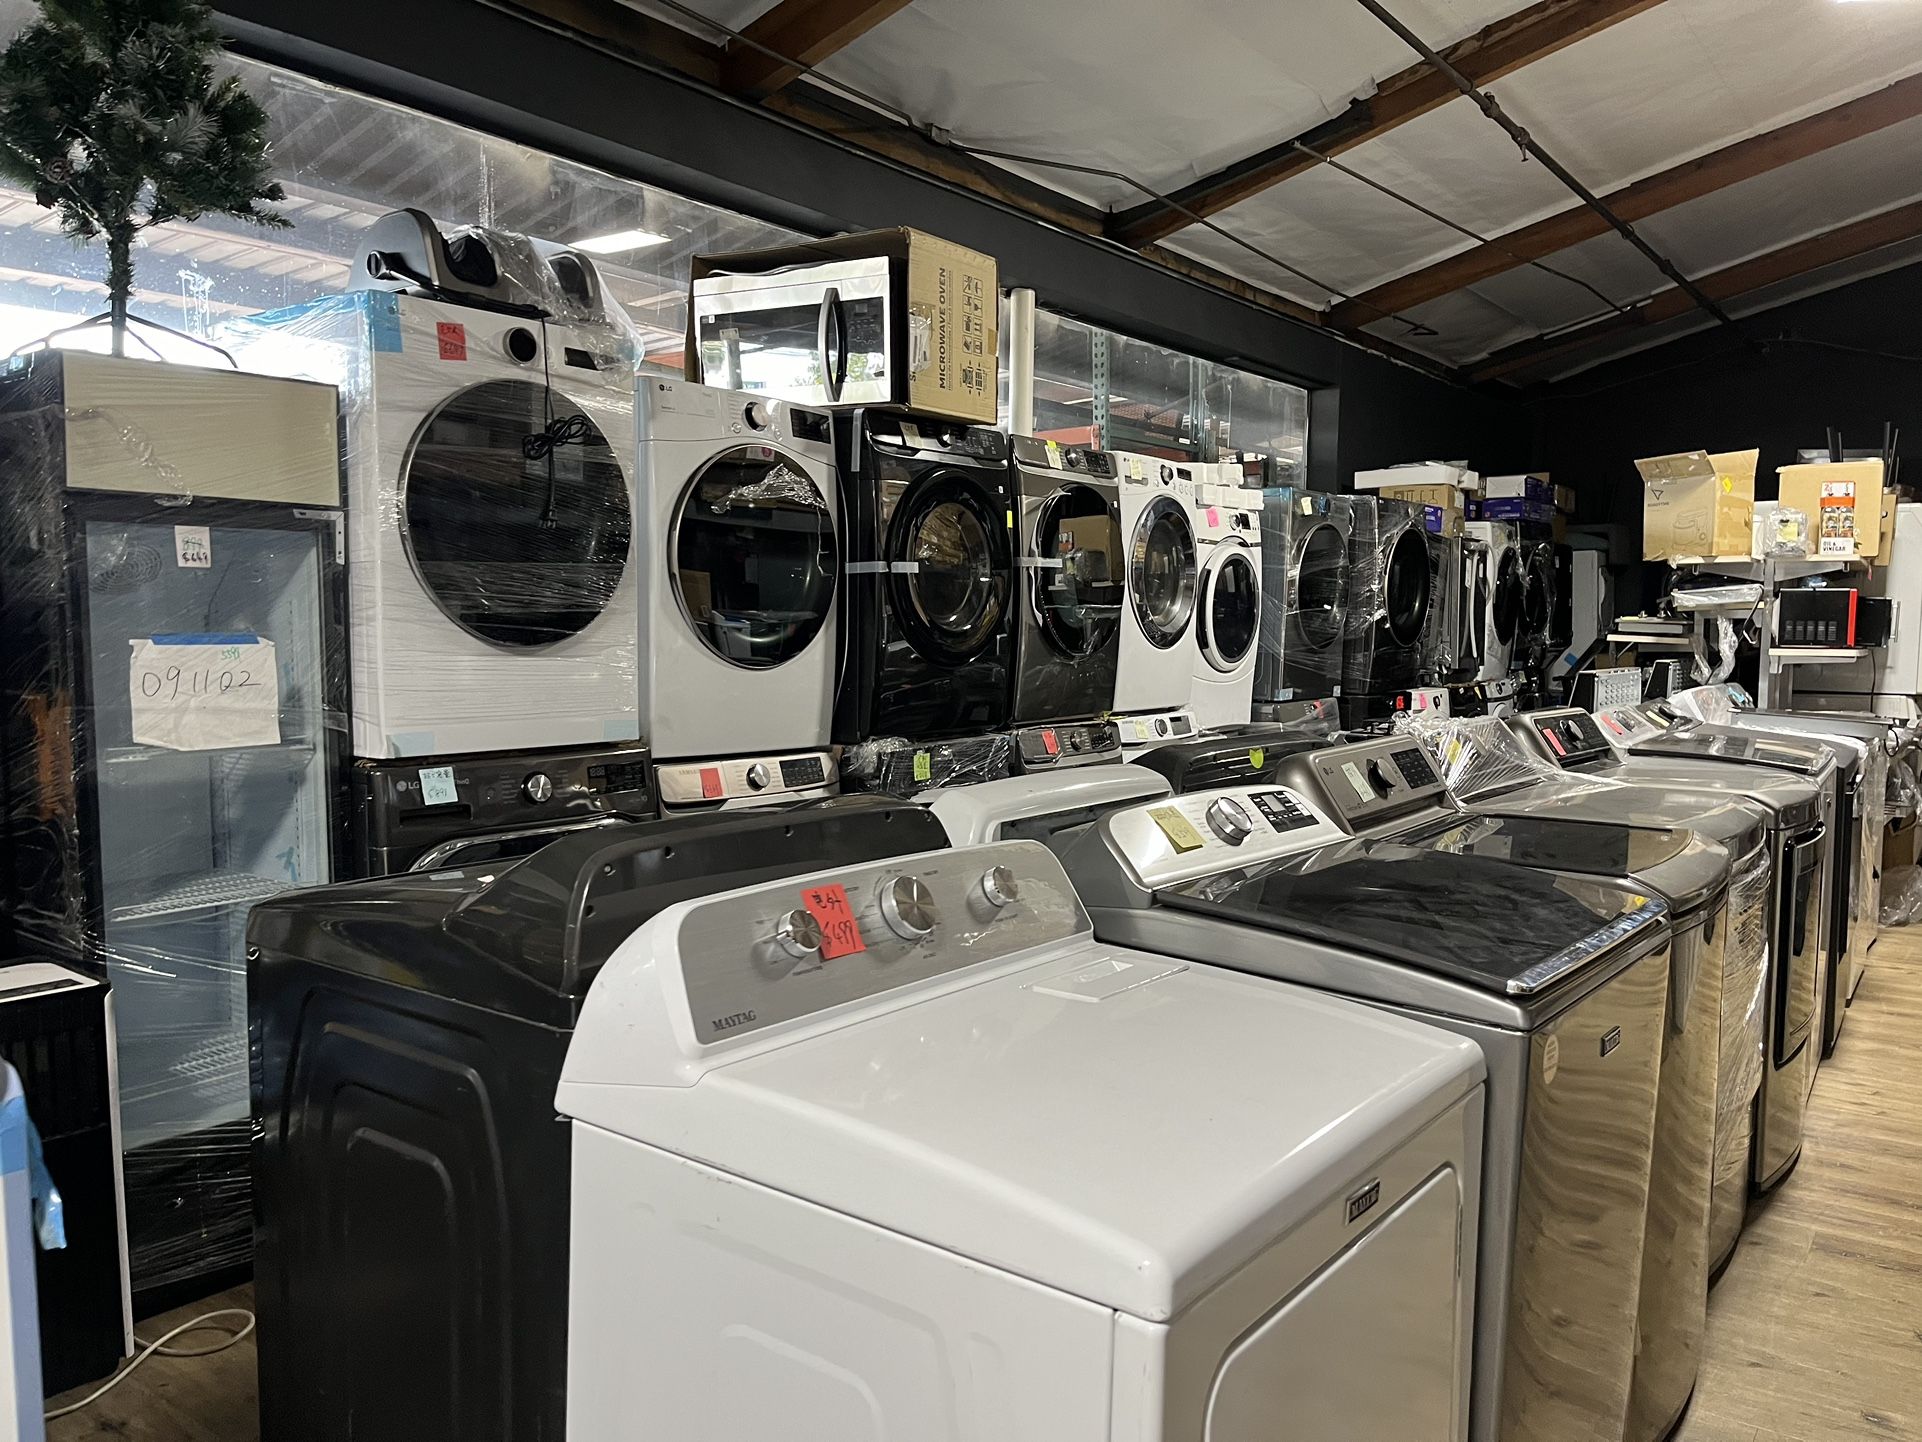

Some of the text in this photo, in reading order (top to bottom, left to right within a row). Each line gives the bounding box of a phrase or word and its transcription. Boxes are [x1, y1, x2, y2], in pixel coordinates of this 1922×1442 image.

[142, 665, 261, 701] 091102
[408, 781, 420, 789] LG
[712, 1009, 757, 1032] MAYTAG
